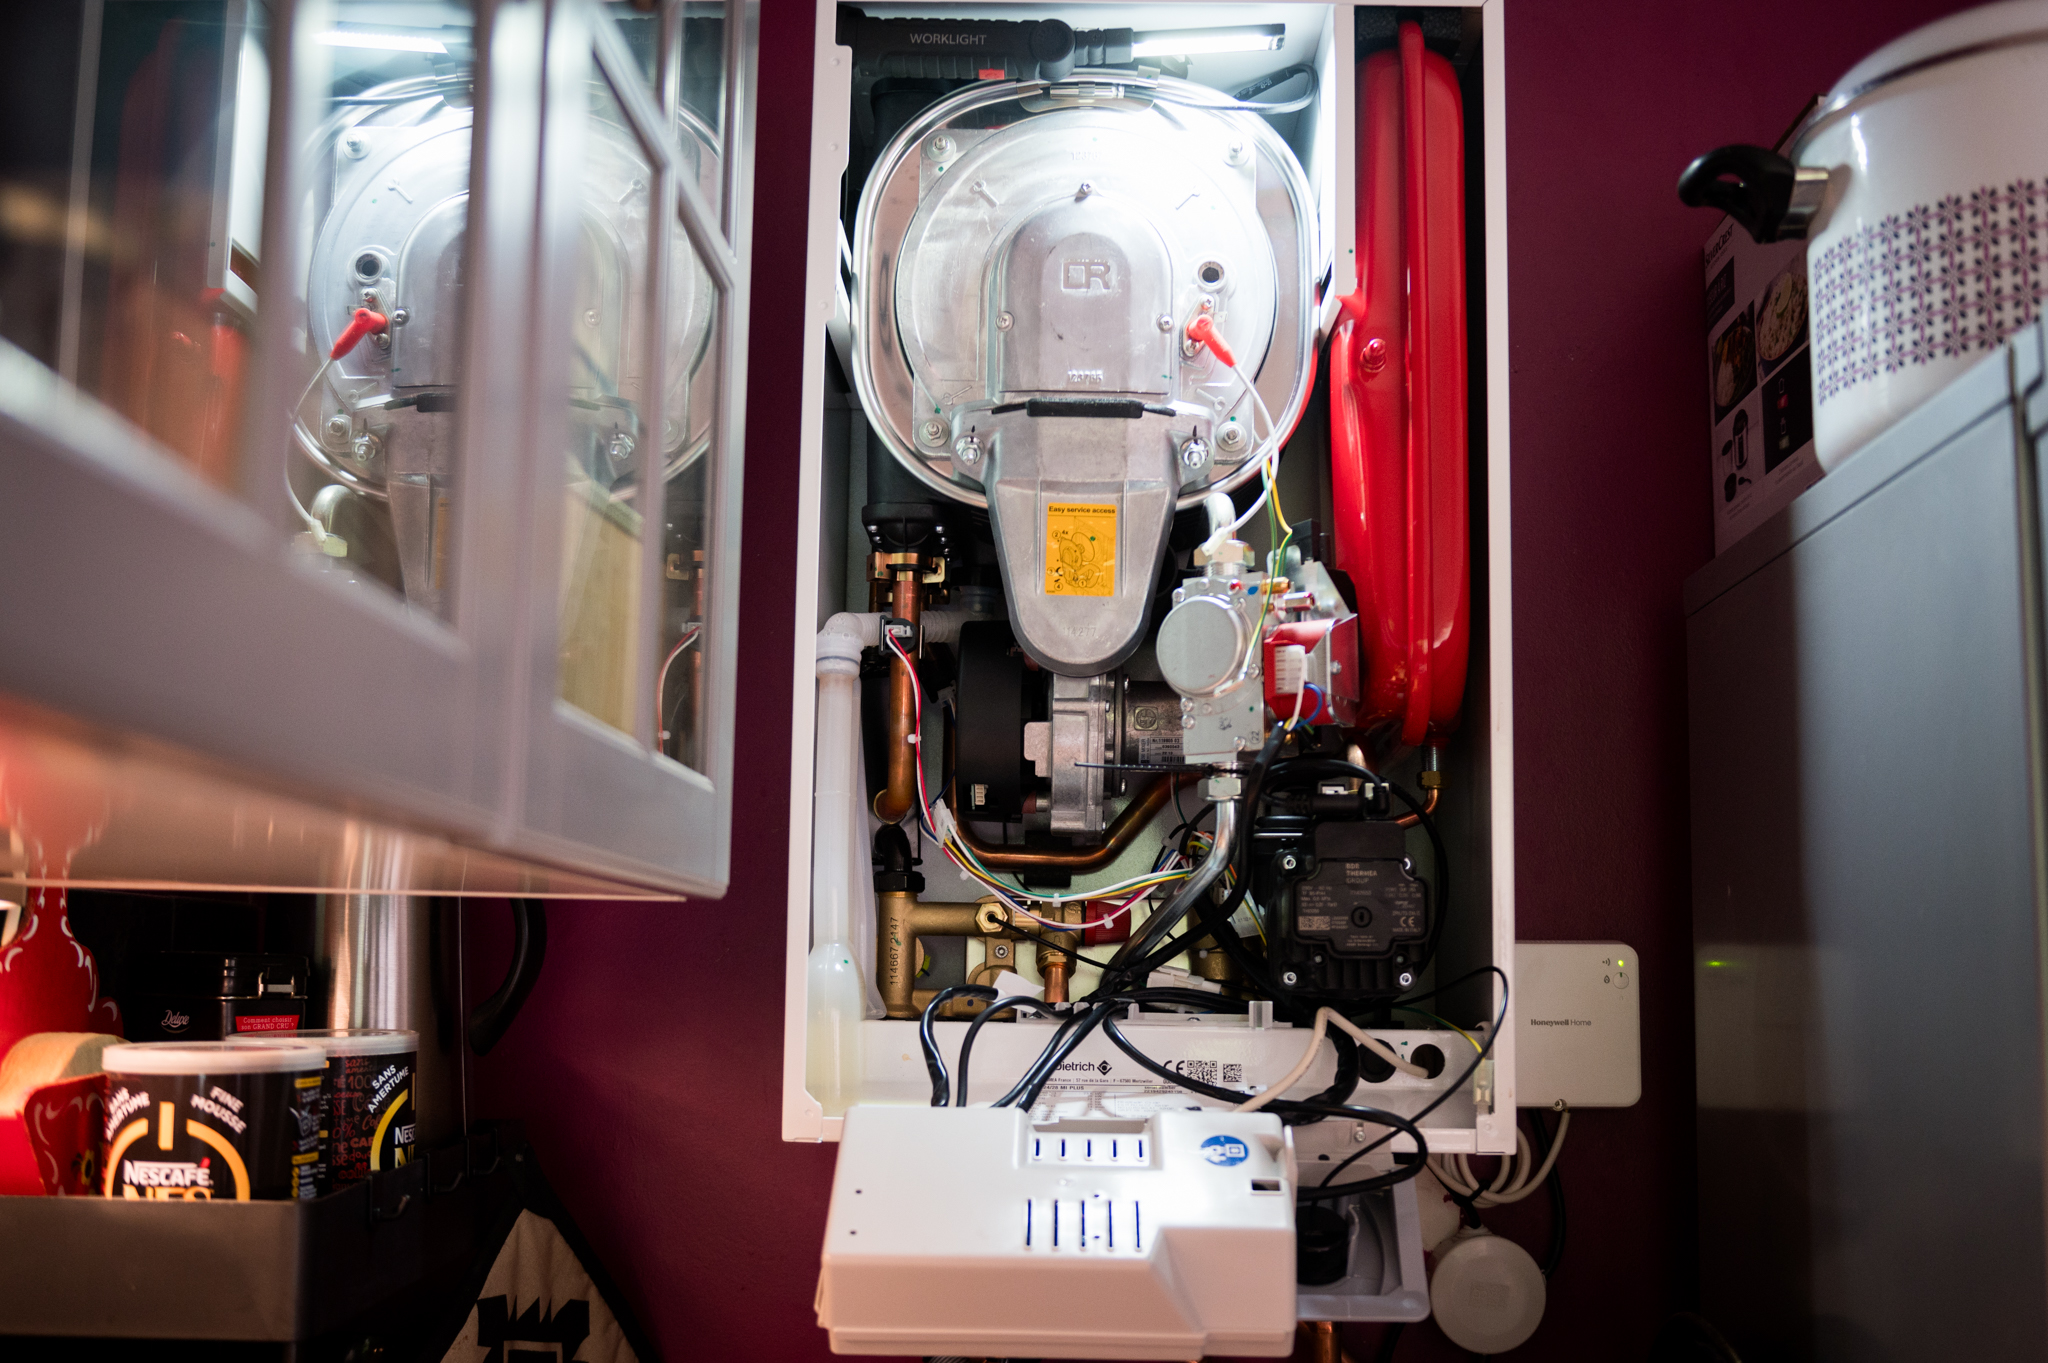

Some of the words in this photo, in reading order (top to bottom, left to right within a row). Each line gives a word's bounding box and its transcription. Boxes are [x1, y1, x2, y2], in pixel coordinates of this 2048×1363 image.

[909, 33, 987, 45] WORKLIGHT
[1049, 505, 1066, 514] Easy
[161, 1009, 190, 1028] Deluxe
[243, 1016, 271, 1024] Comment
[1530, 1018, 1569, 1027] Honeywell
[1570, 1018, 1592, 1026] Home
[371, 1064, 397, 1090] SANS
[210, 1085, 245, 1114] FINE
[367, 1065, 409, 1114] AMERTUME
[190, 1093, 247, 1135] MOUSSE
[123, 1157, 211, 1187] NESCAFÉ
